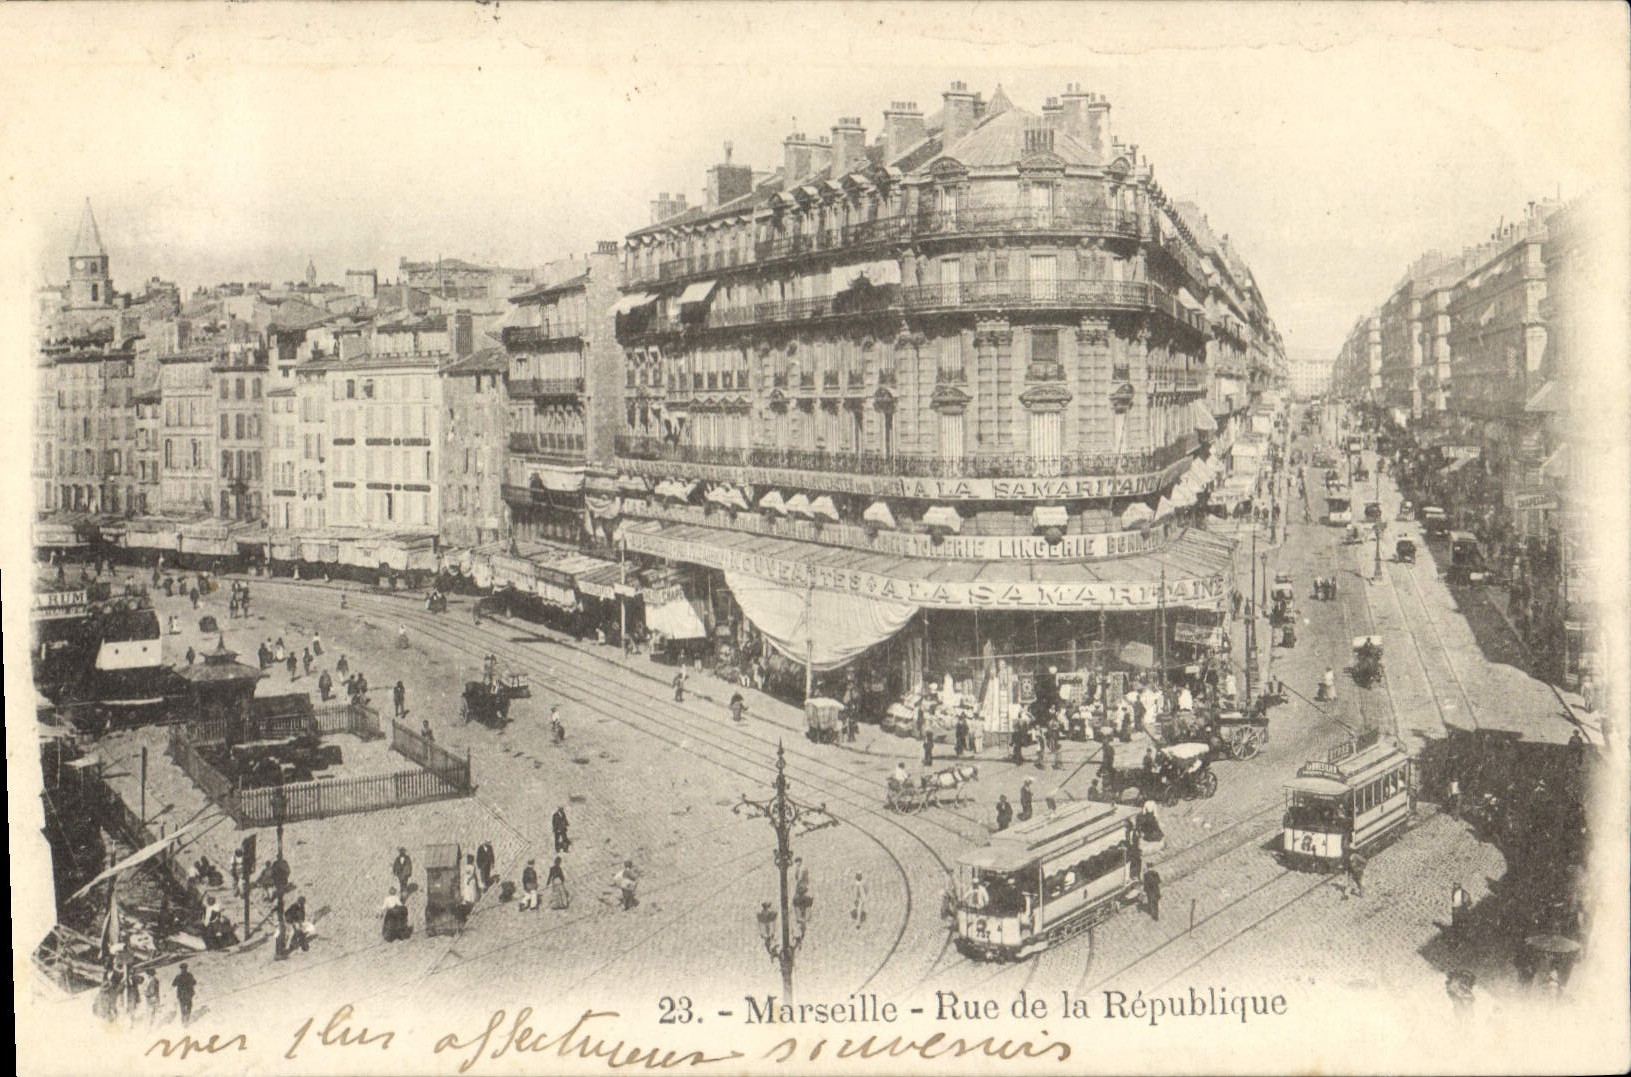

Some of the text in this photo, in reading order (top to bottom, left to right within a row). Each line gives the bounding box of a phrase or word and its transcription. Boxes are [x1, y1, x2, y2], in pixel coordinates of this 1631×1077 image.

[933, 481, 980, 498] LA
[999, 536, 1095, 559] LINGERIE
[908, 583, 957, 605] LA
[284, 1004, 395, 1059] plus
